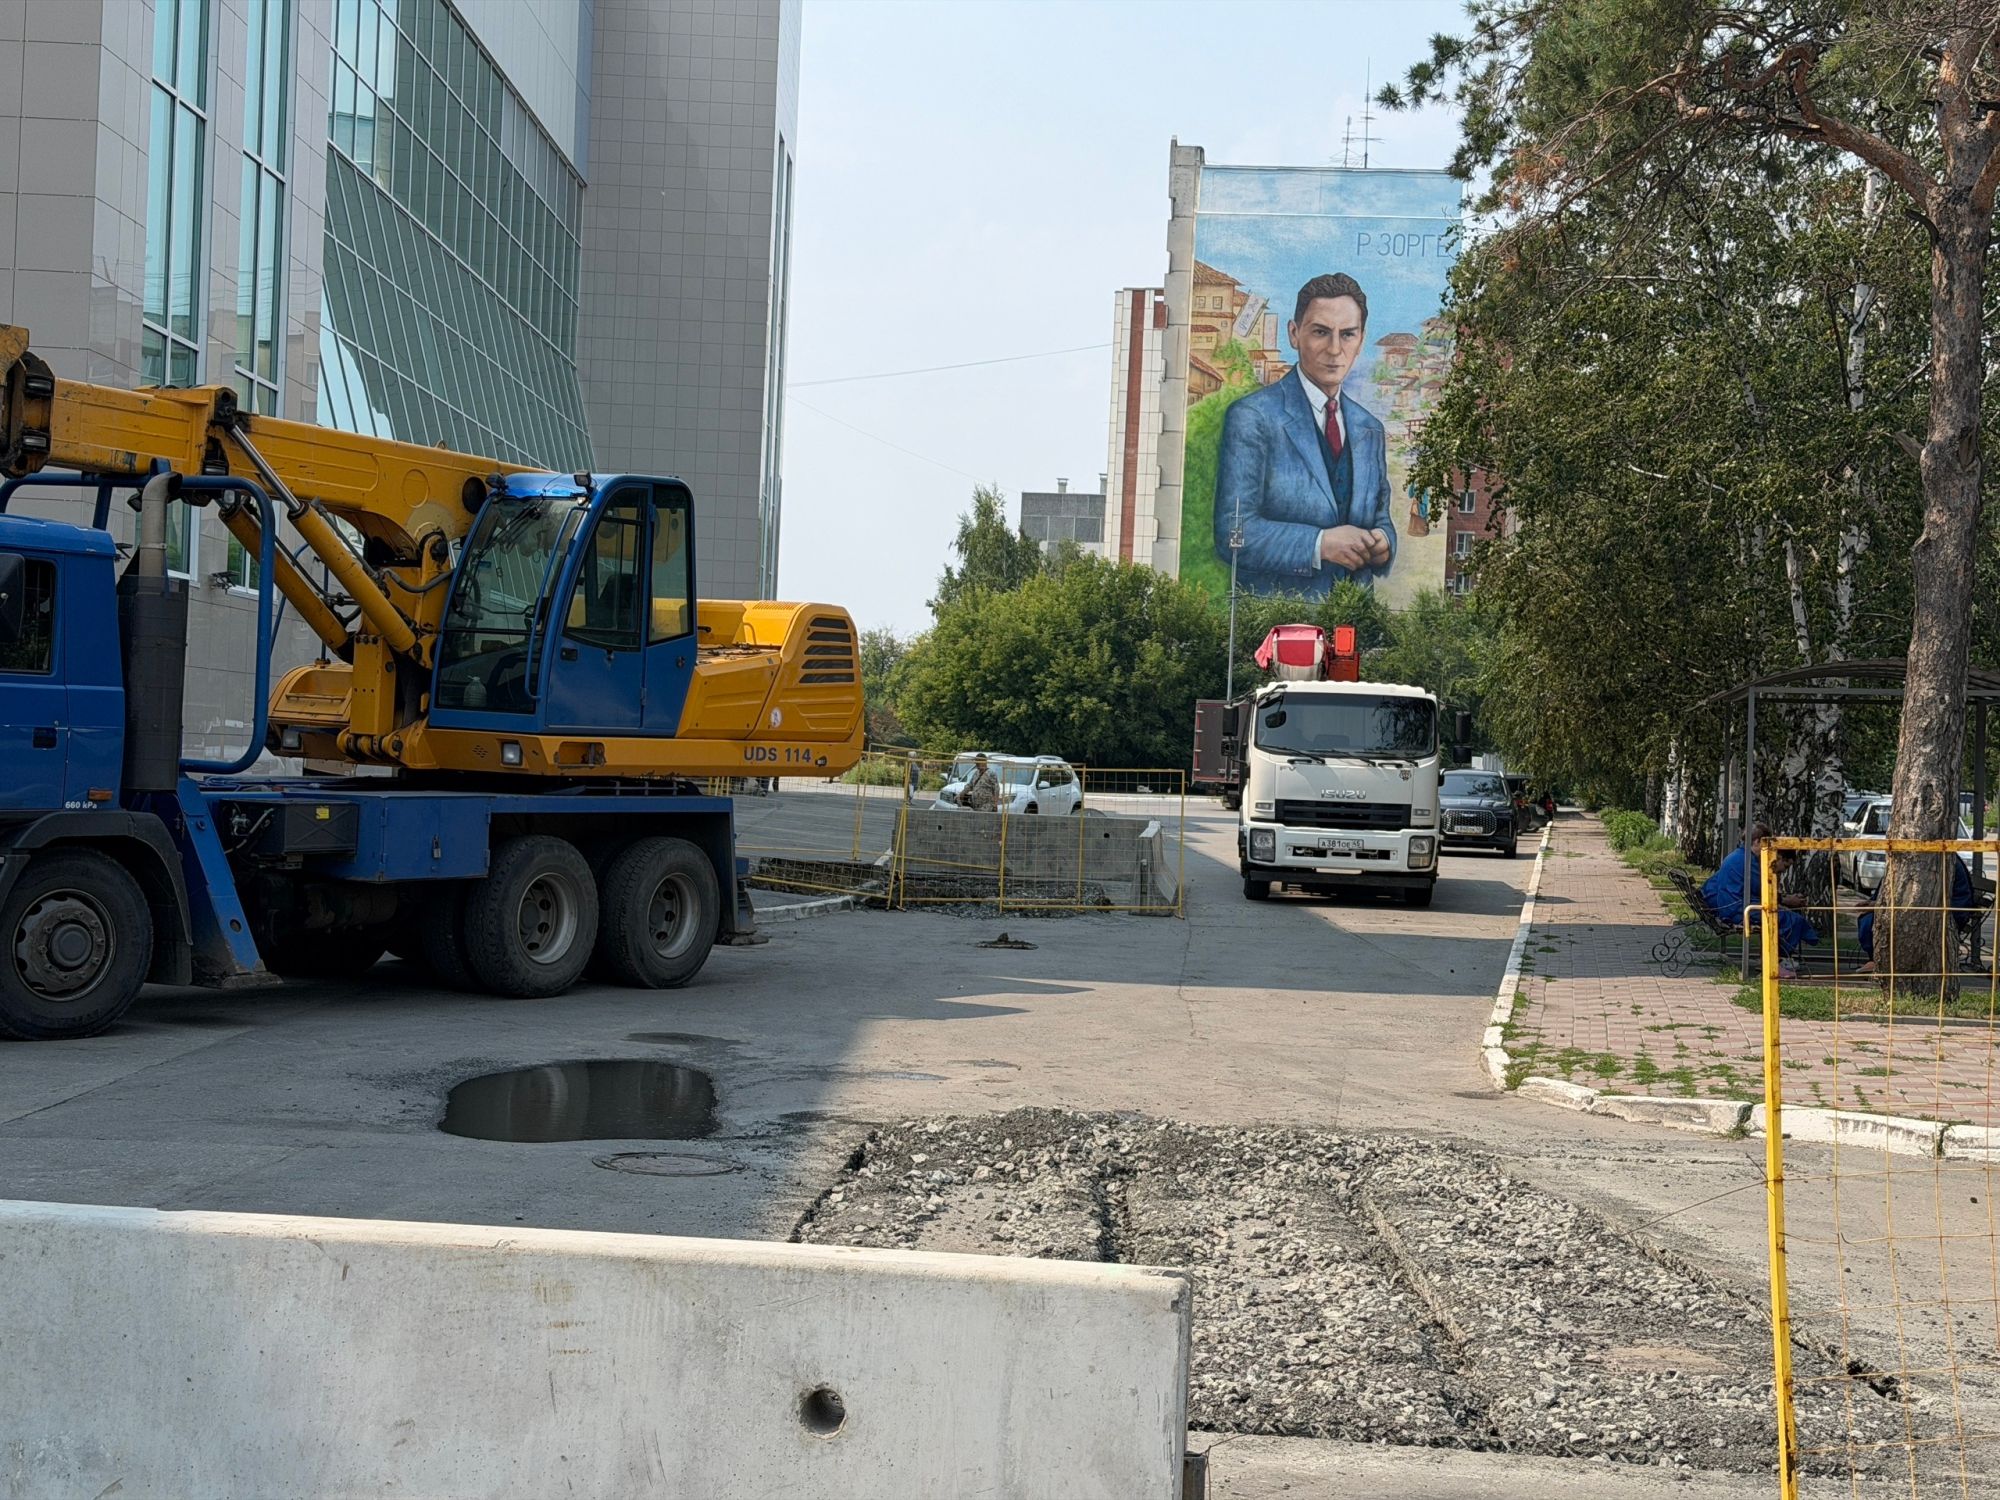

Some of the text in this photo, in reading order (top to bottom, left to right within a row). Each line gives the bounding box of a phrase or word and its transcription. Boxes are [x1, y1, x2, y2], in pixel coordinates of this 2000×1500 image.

[1357, 232, 1450, 258] Р ЗОРГЕ
[744, 746, 811, 762] UDS 114
[1321, 789, 1366, 799] ISUZU
[65, 801, 97, 809] 660 kPa
